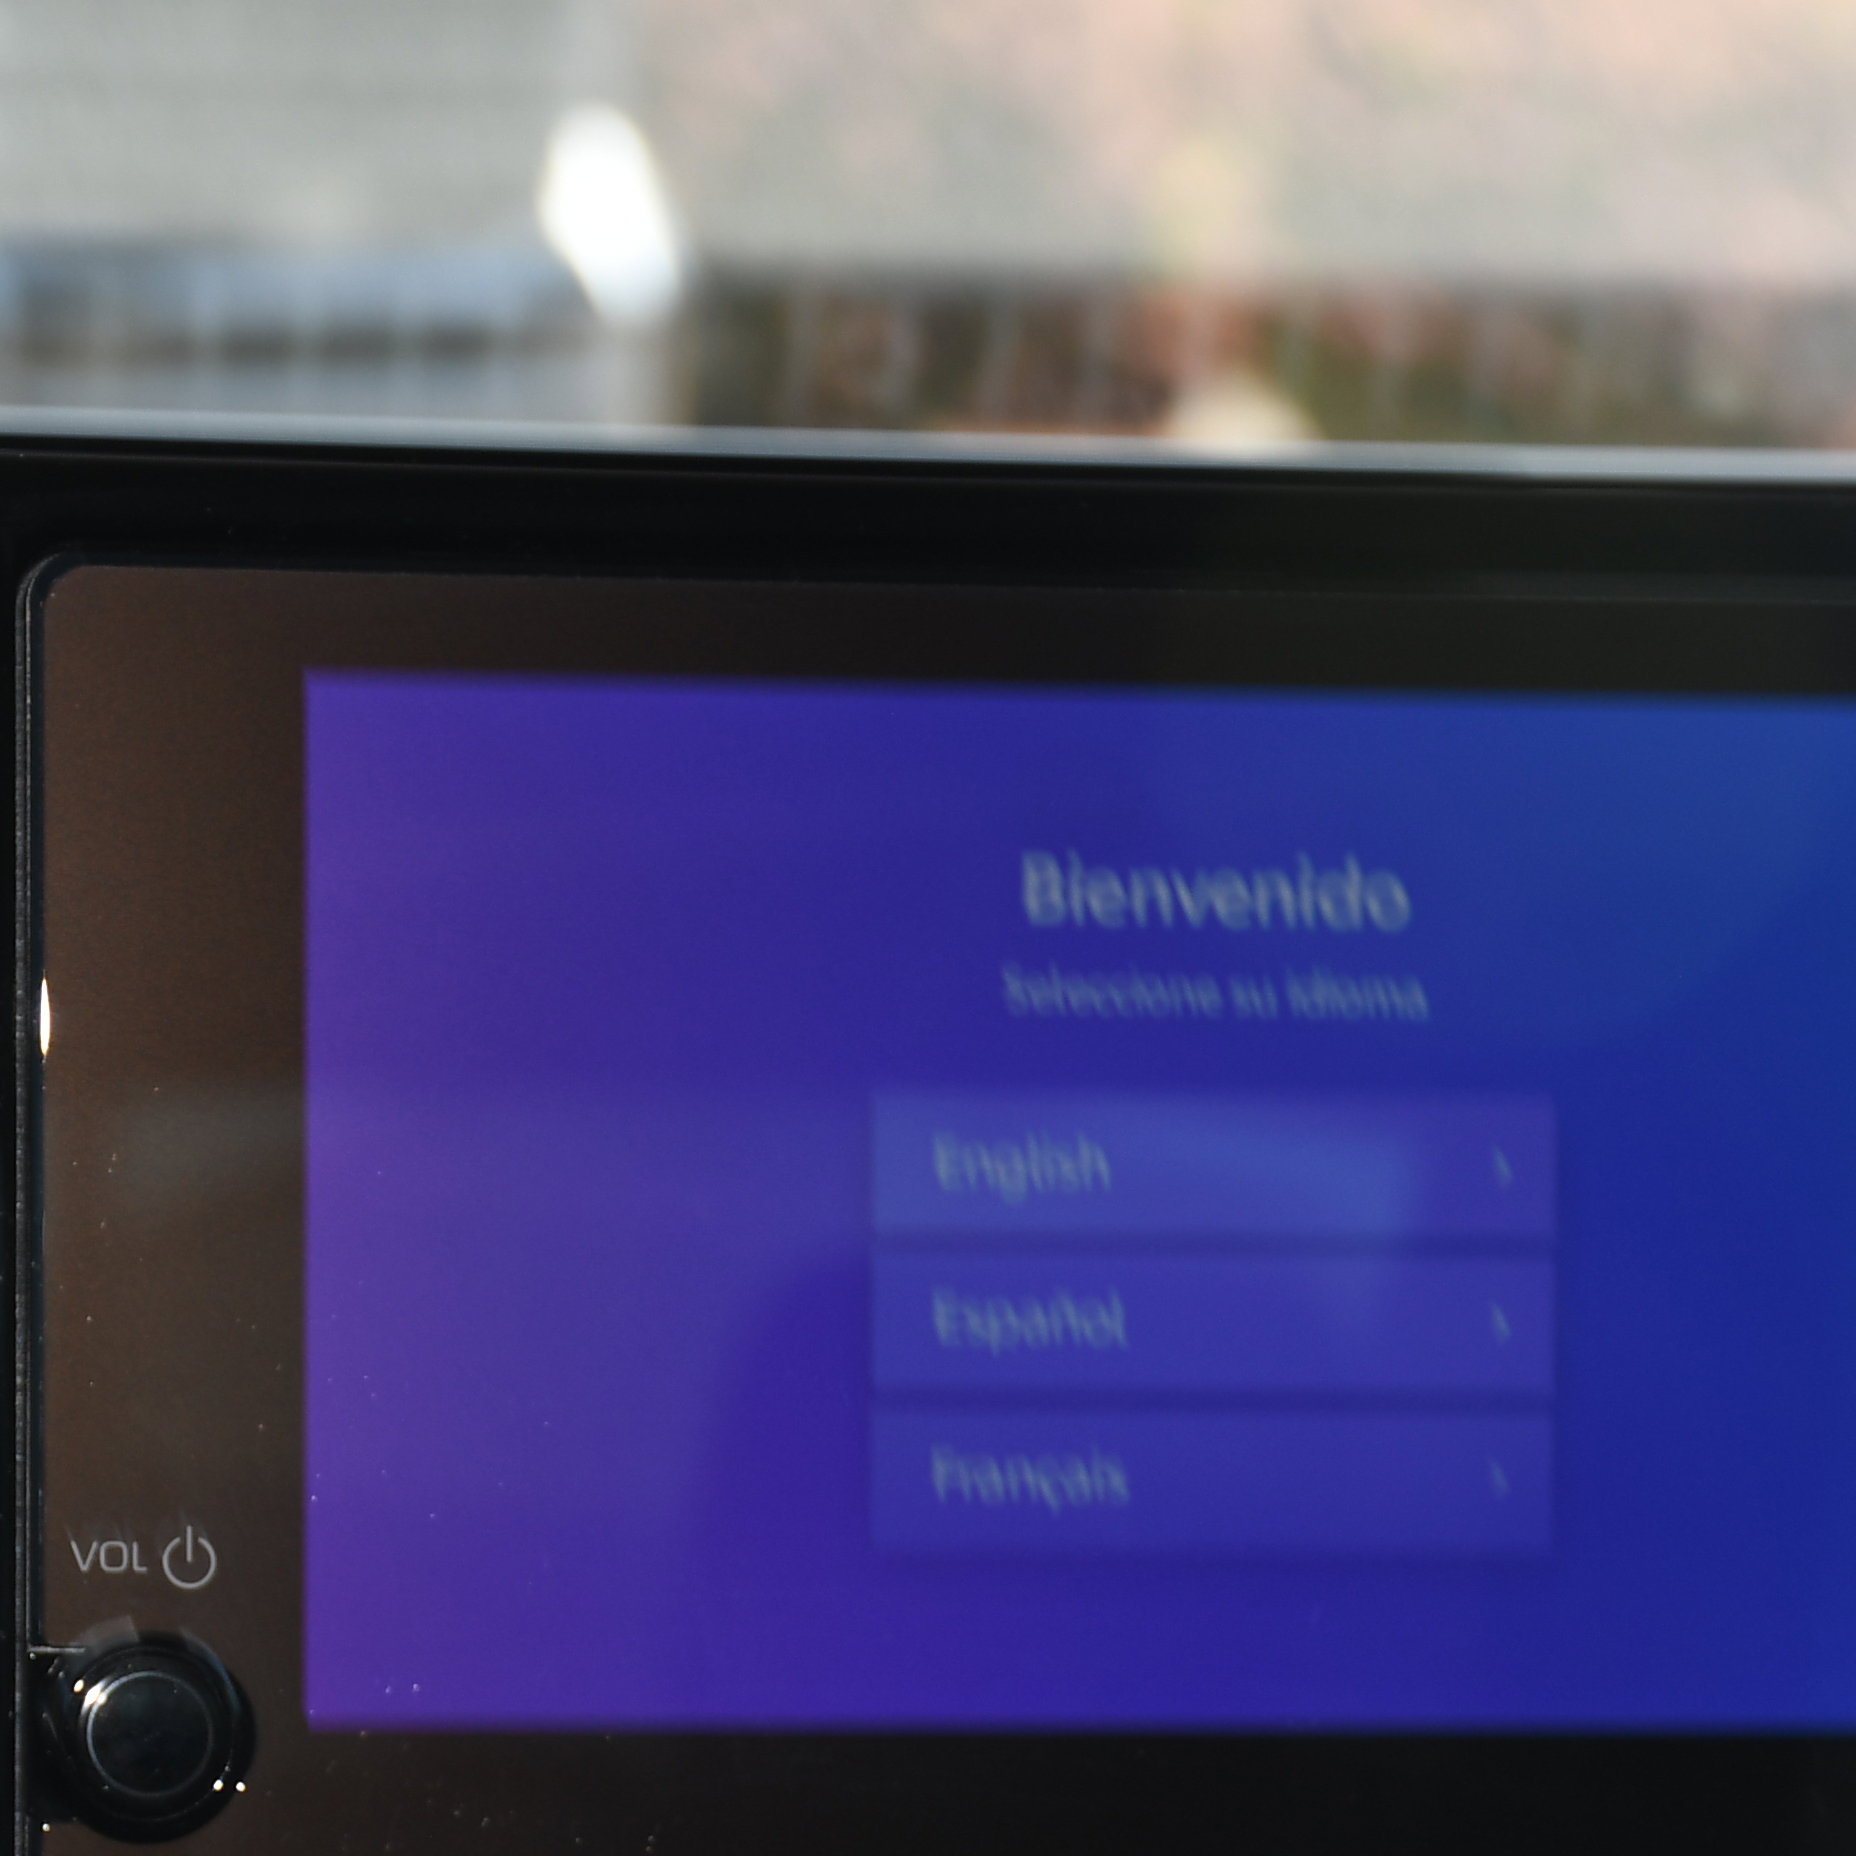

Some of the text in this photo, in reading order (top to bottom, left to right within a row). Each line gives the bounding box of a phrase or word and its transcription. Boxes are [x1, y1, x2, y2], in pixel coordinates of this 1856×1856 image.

[1021, 852, 1411, 932] Bienvenido
[1230, 974, 1279, 1020] su
[1285, 968, 1429, 1023] idioma
[934, 1131, 1111, 1206] English
[934, 1286, 1127, 1355] Español
[931, 1444, 1129, 1516] Français
[70, 1540, 148, 1573] VOL
